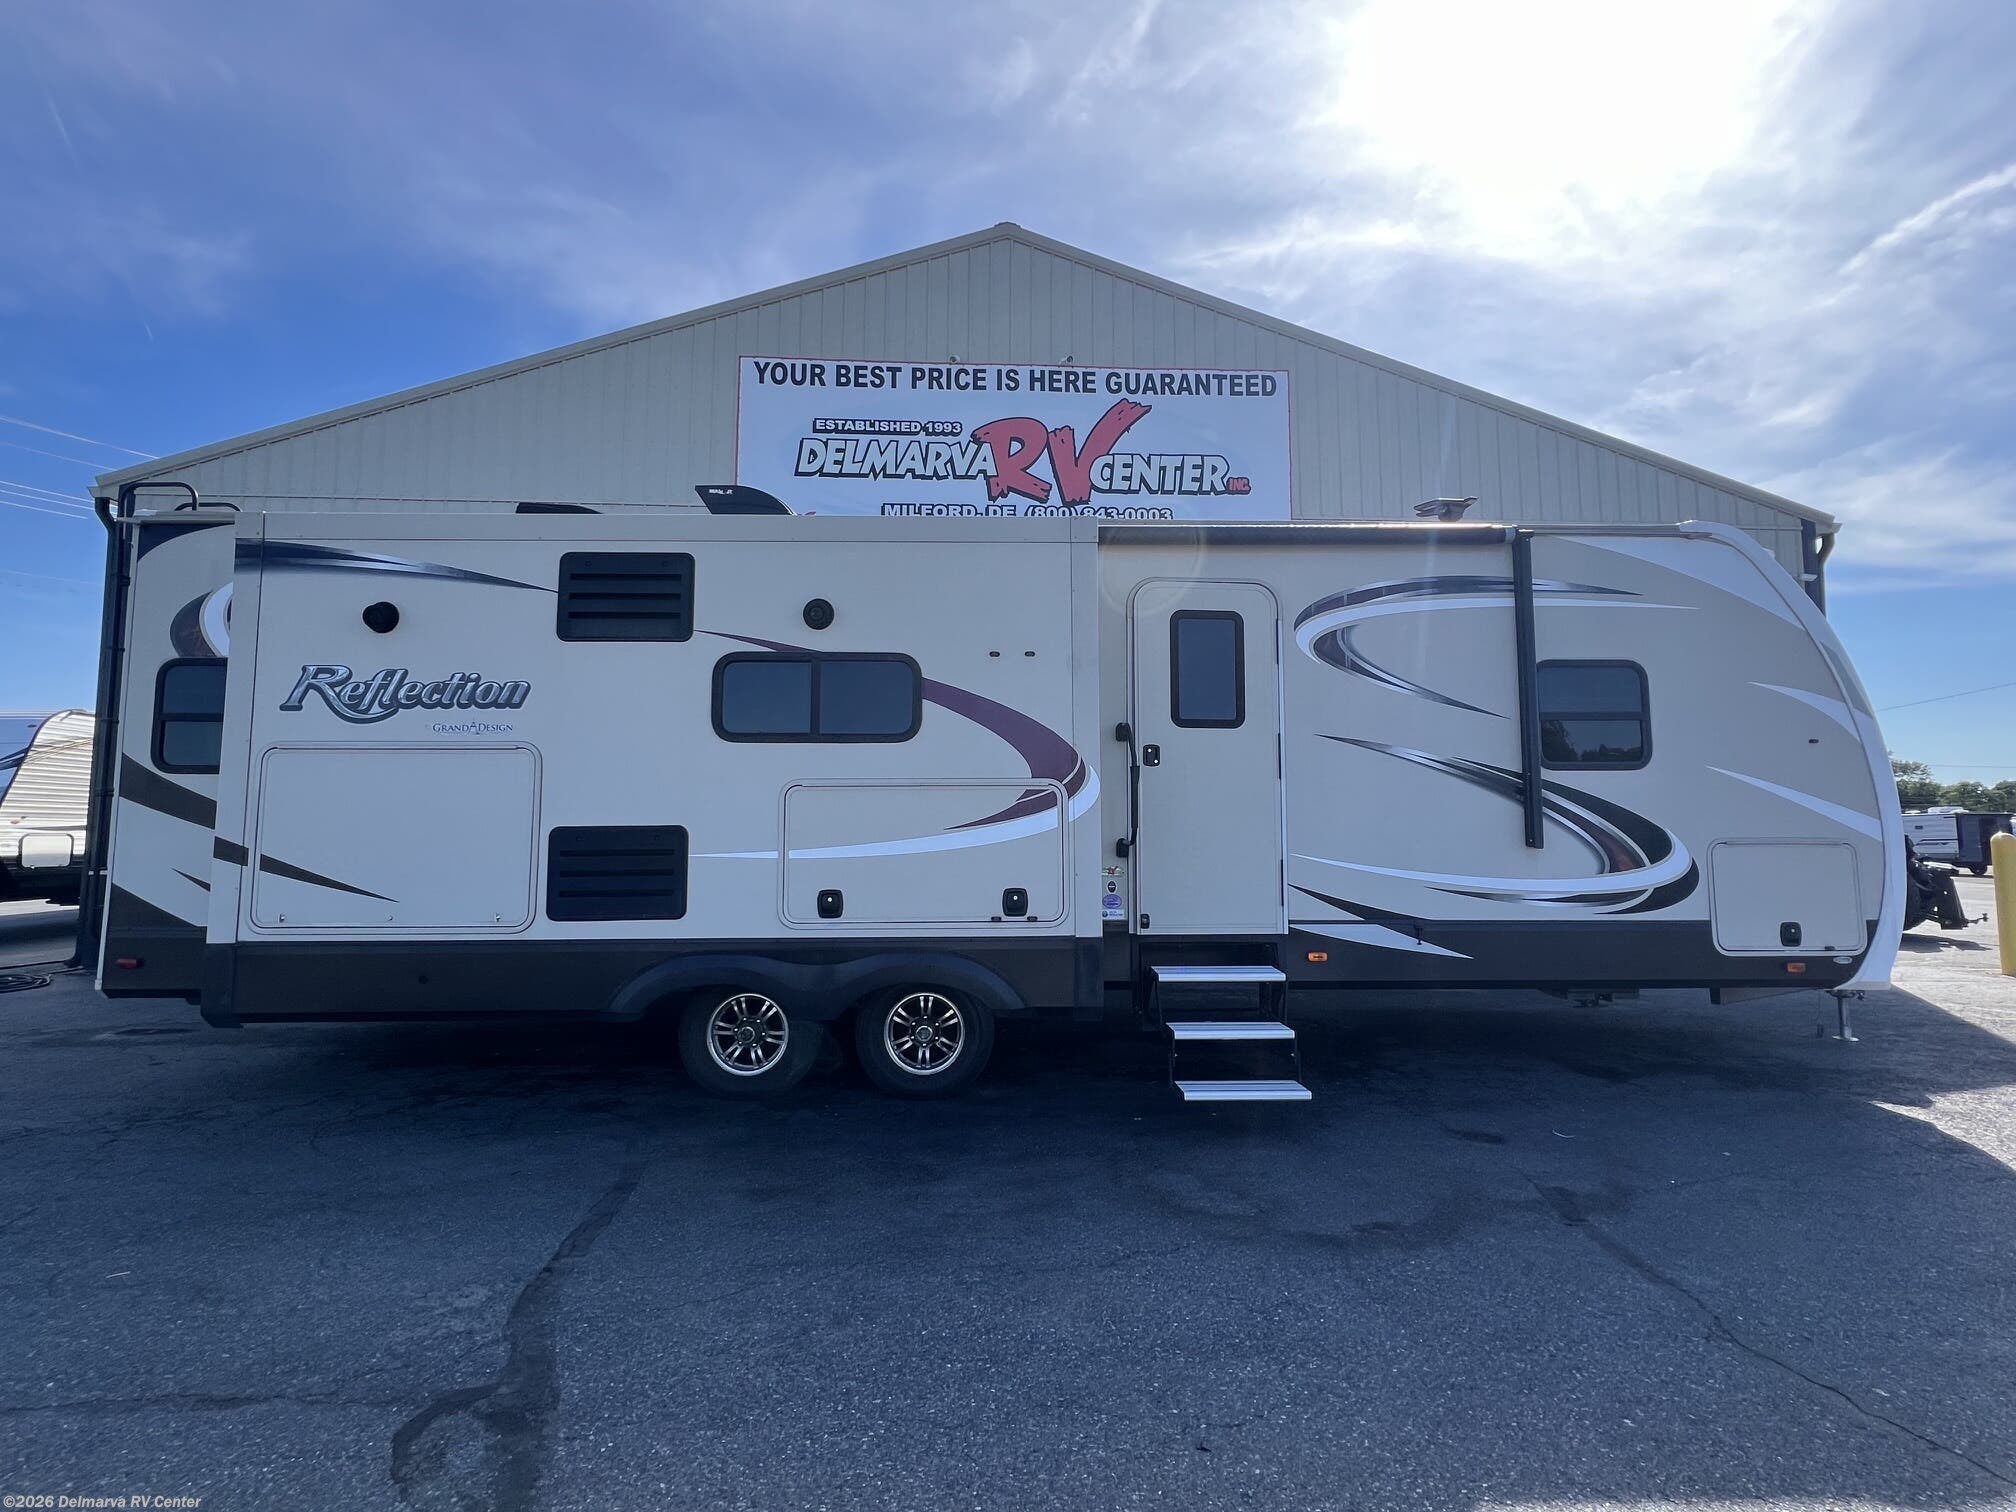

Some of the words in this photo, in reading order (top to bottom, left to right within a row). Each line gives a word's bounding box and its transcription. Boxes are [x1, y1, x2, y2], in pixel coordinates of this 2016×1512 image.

[753, 361, 827, 387] YOUR
[835, 364, 902, 389] BEST
[911, 367, 987, 391] PRICE
[996, 368, 1020, 392] IS
[1029, 369, 1097, 394] HERE
[1105, 371, 1277, 397] GUARANTEED
[813, 418, 921, 435] ESTABLISHED
[924, 421, 963, 436] 1993
[795, 438, 999, 480] DELMARVA
[971, 398, 1152, 504] RV
[1089, 453, 1230, 495] CENTER
[986, 504, 1016, 517] DE
[1024, 505, 1078, 517] (800)
[1080, 506, 1174, 520] 843-0003
[279, 664, 531, 724] Reflection
